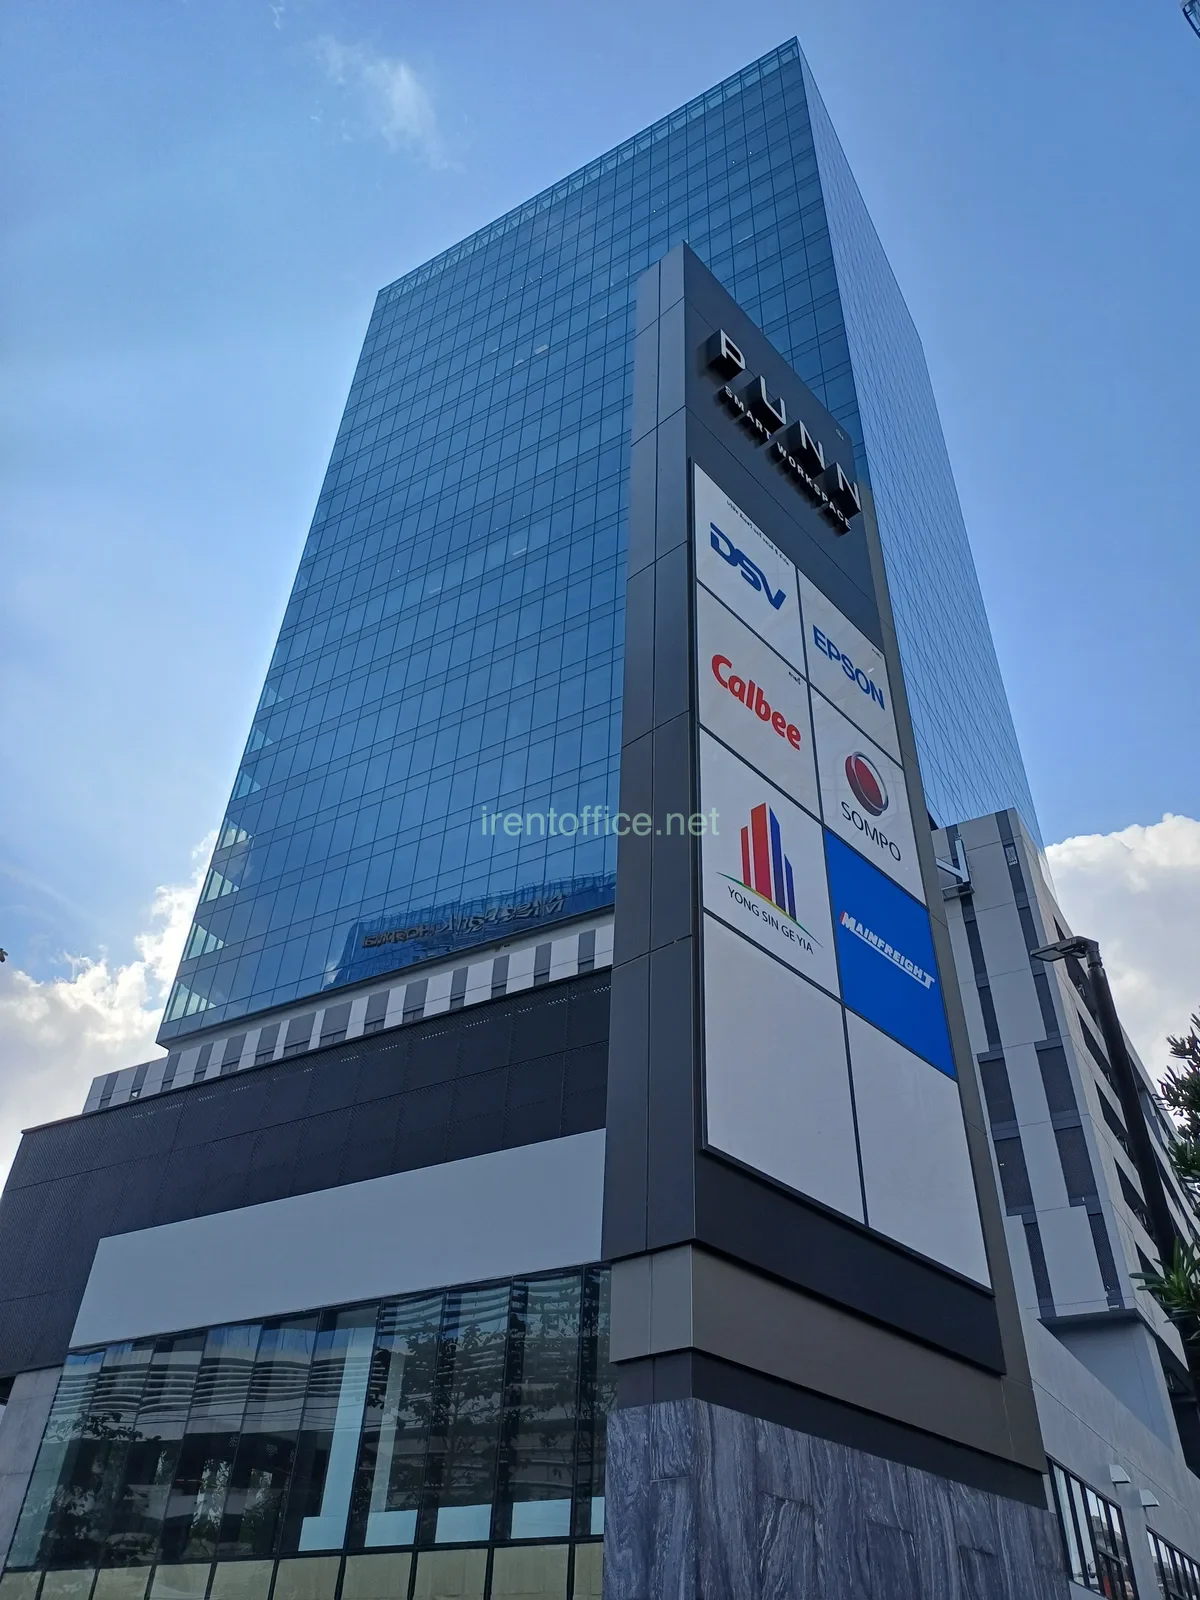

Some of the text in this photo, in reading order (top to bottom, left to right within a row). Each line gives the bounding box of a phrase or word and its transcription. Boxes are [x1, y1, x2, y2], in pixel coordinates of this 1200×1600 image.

[719, 328, 862, 512] PUNN
[724, 385, 771, 441] SMART
[776, 441, 851, 530] WORKSPACE
[710, 521, 787, 610] DSV
[711, 653, 801, 751] Calbee
[812, 624, 886, 711] EPSON
[840, 801, 901, 862] SOMPO
[727, 885, 814, 955] YONG SIN GE YIA
[840, 910, 936, 990] MAINFREIGHT
